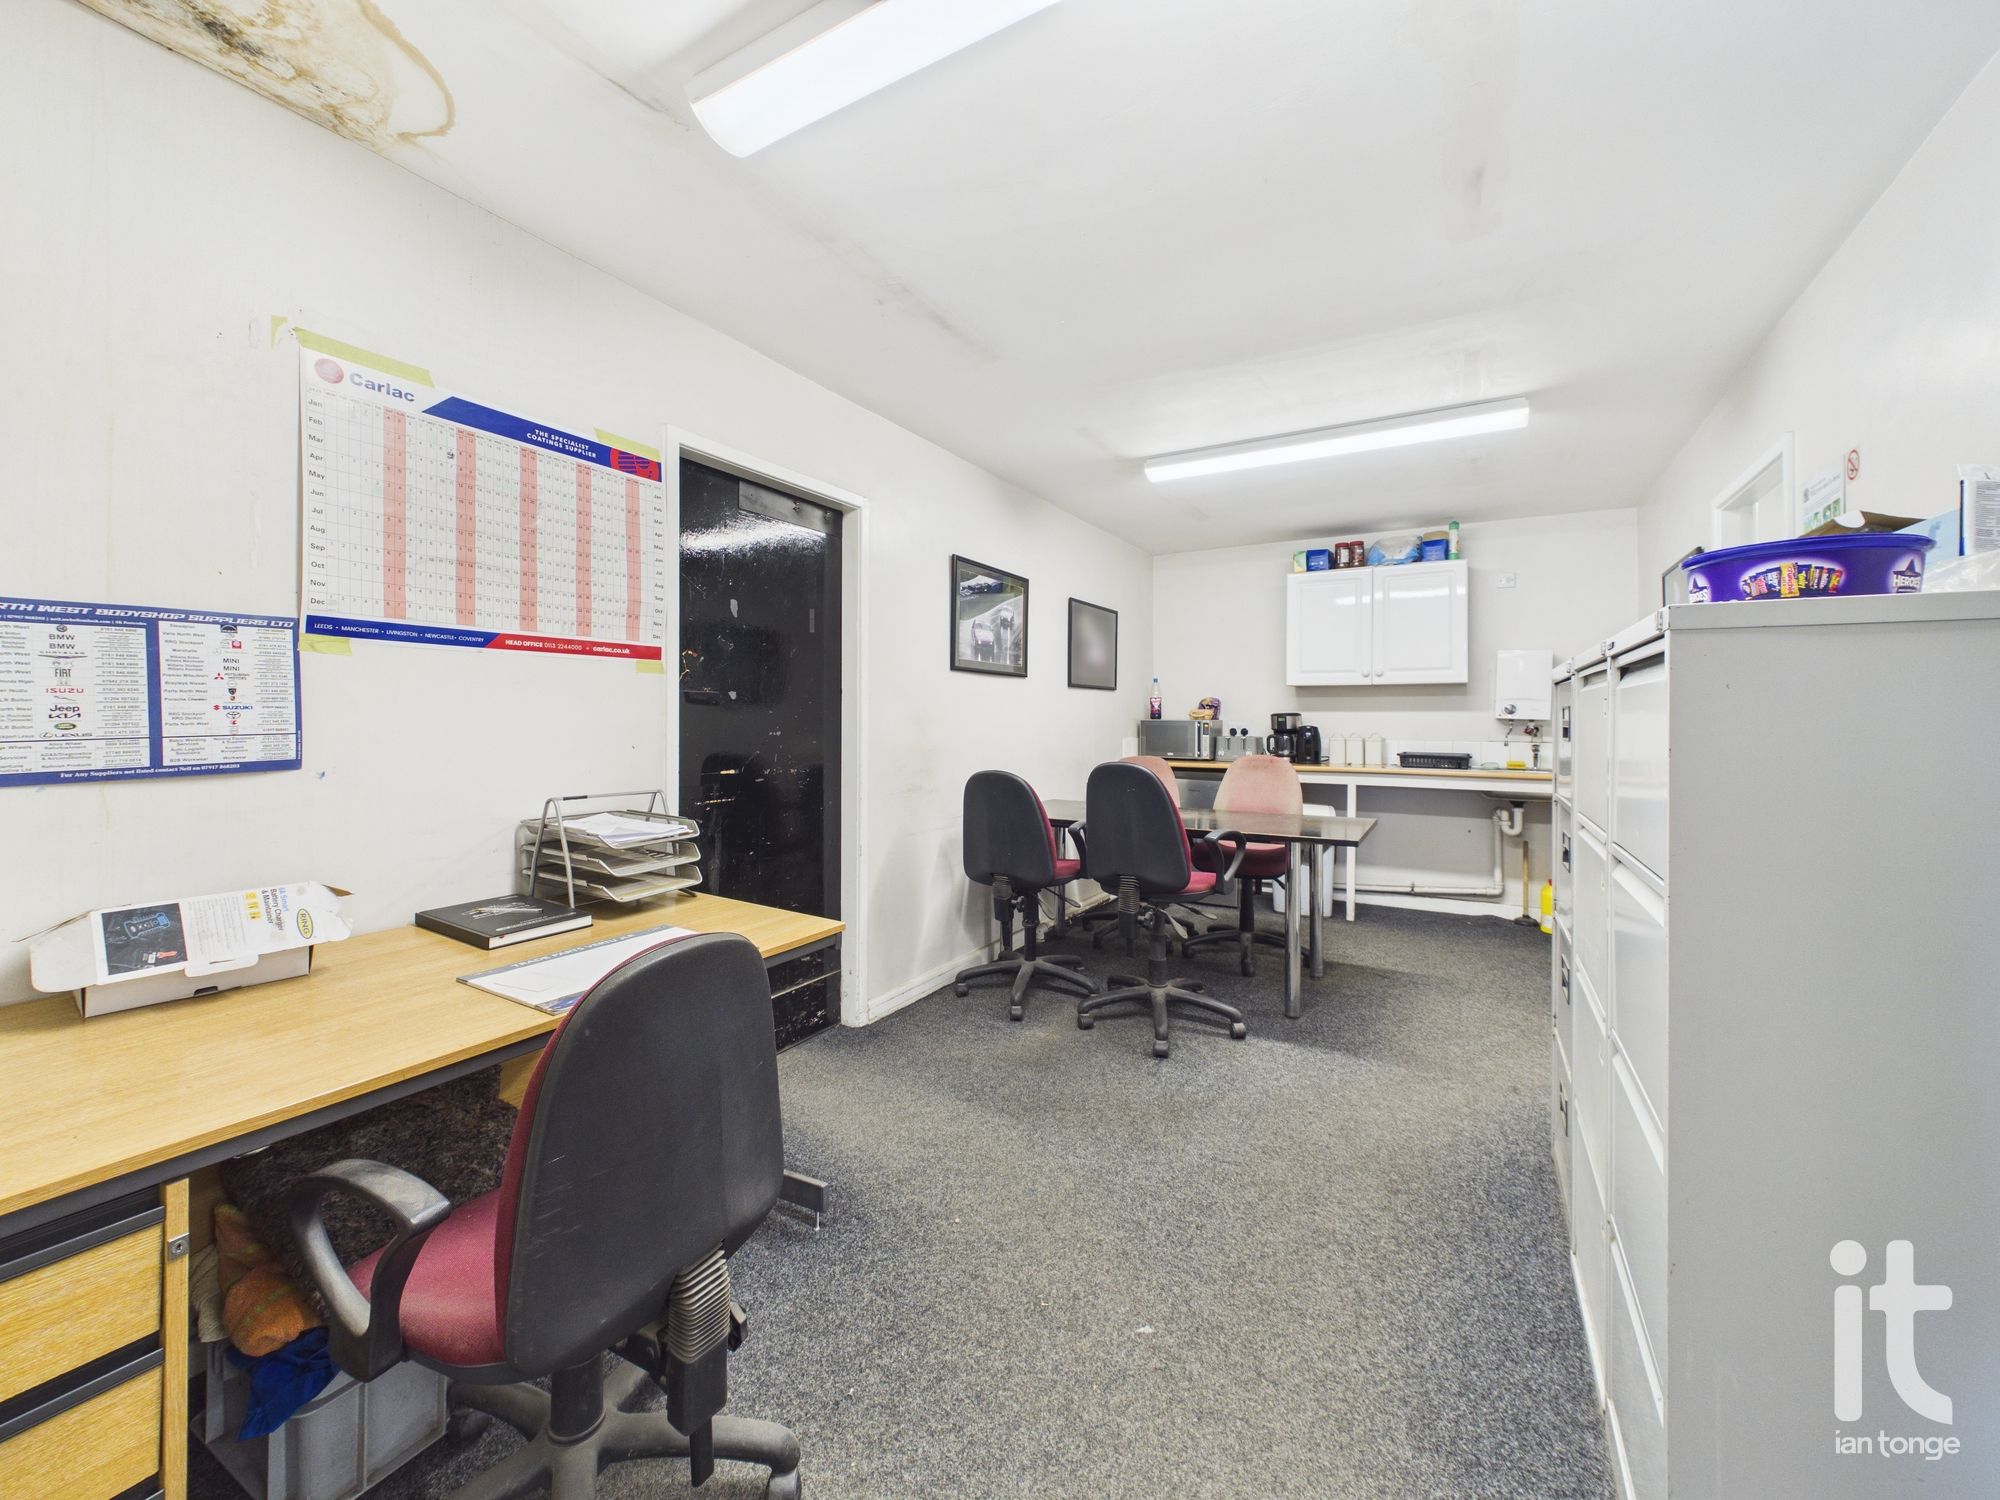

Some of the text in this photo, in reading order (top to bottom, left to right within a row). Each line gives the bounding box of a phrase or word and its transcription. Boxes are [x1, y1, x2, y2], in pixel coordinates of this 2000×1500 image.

[349, 372, 415, 402] Carlac
[308, 399, 323, 408] Jan
[308, 416, 323, 426] Feb
[308, 434, 323, 443] Mar
[535, 429, 589, 451] THE SPECIALIST
[526, 433, 597, 458] COATINGS SUPPLIER
[310, 452, 323, 461] Apr
[309, 470, 325, 480] May
[310, 488, 325, 497] Jun
[311, 507, 323, 515] Jul
[310, 525, 326, 534] Aug
[310, 543, 326, 552] Sep
[311, 561, 325, 569] Oct
[310, 579, 326, 587] Nov
[1892, 575, 1921, 587] HEROES
[310, 597, 326, 605] Dec
[37, 604, 93, 614] WEST
[94, 608, 186, 620] BODYSHOP
[187, 614, 268, 625] SUPPLIERS
[341, 625, 379, 634] MANCHESTER
[386, 629, 418, 637] LIVINGSTON
[523, 640, 543, 648] OFFICE
[592, 646, 631, 654] carlac.co.uk
[54, 668, 72, 677] FIAT
[49, 704, 80, 712] Jeep
[90, 769, 123, 777] Suppliers
[270, 888, 284, 931] Battery Charger
[300, 912, 310, 935] RING
